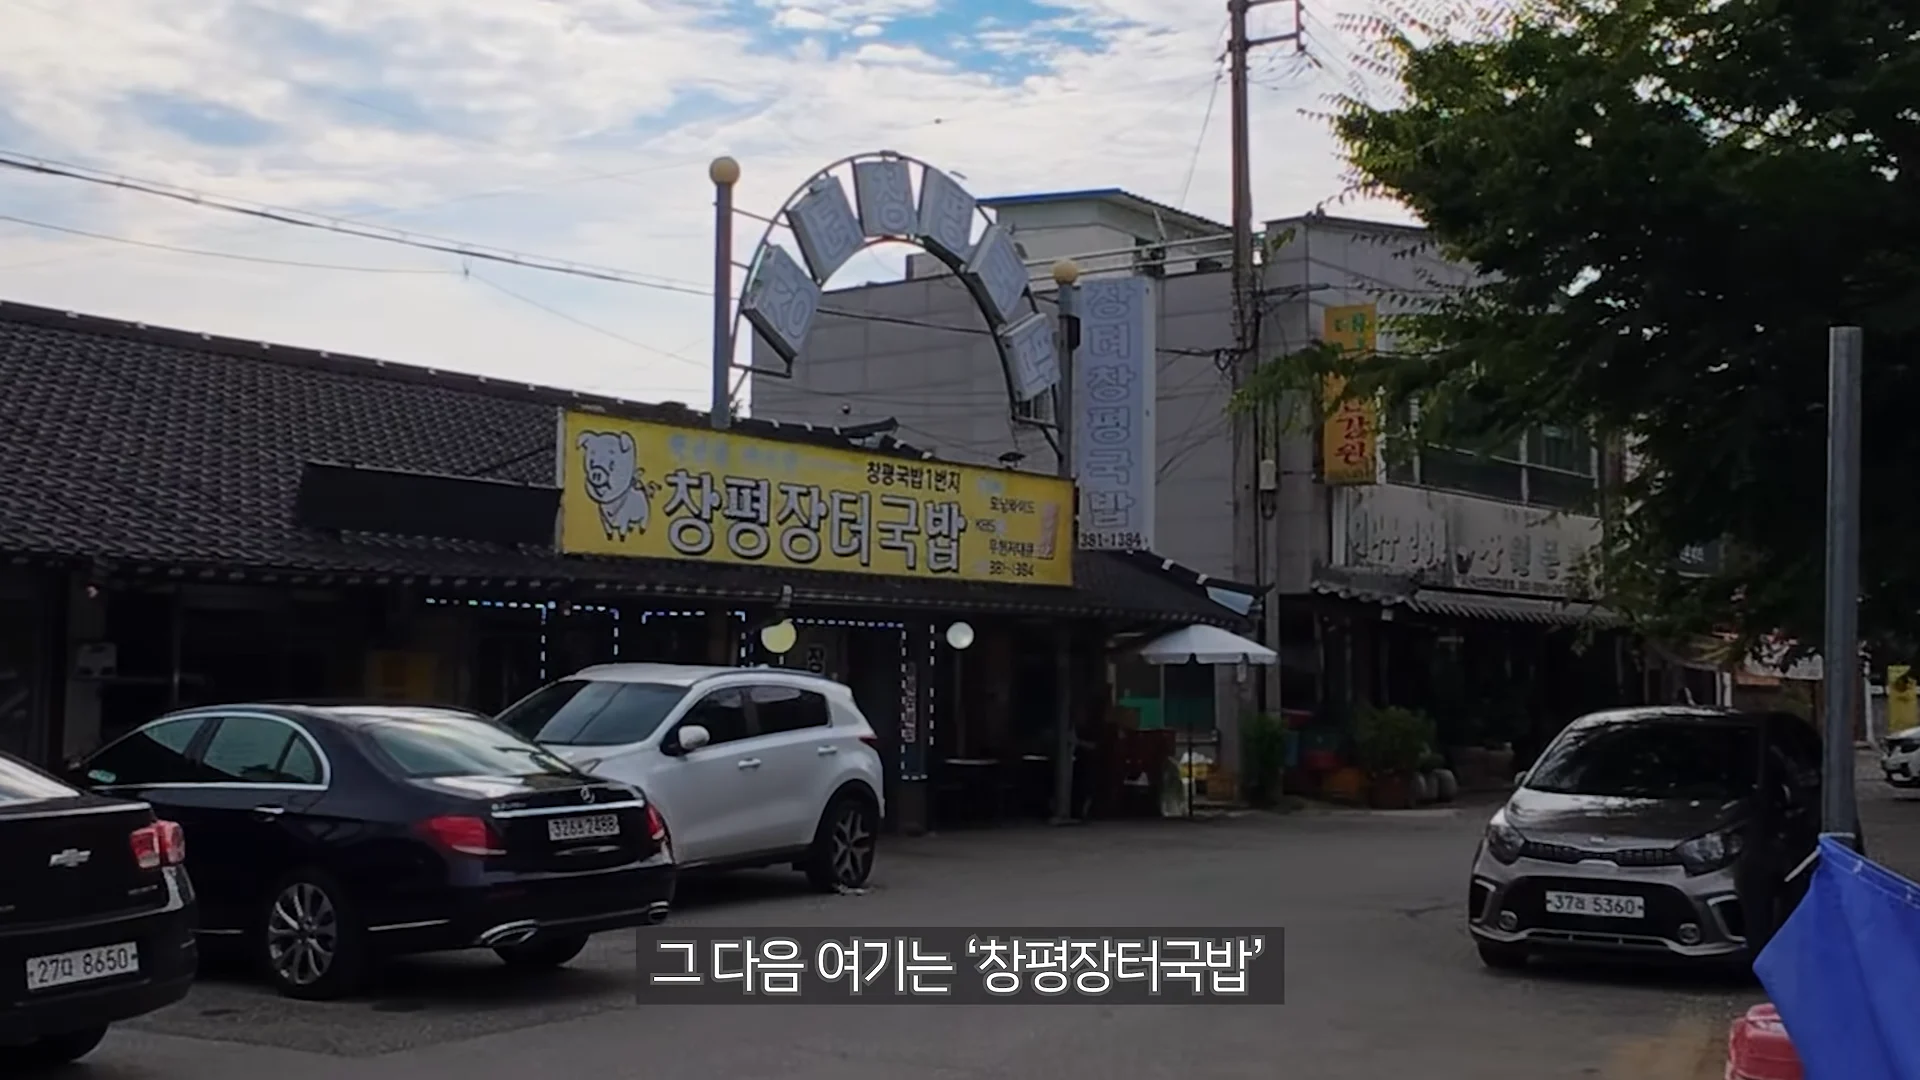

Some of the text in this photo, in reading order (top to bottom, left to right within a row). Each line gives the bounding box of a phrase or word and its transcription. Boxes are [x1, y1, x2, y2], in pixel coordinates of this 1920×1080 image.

[663, 469, 968, 574] 창평장터국밥
[1593, 896, 1636, 915] 5360
[82, 947, 129, 976] 8650
